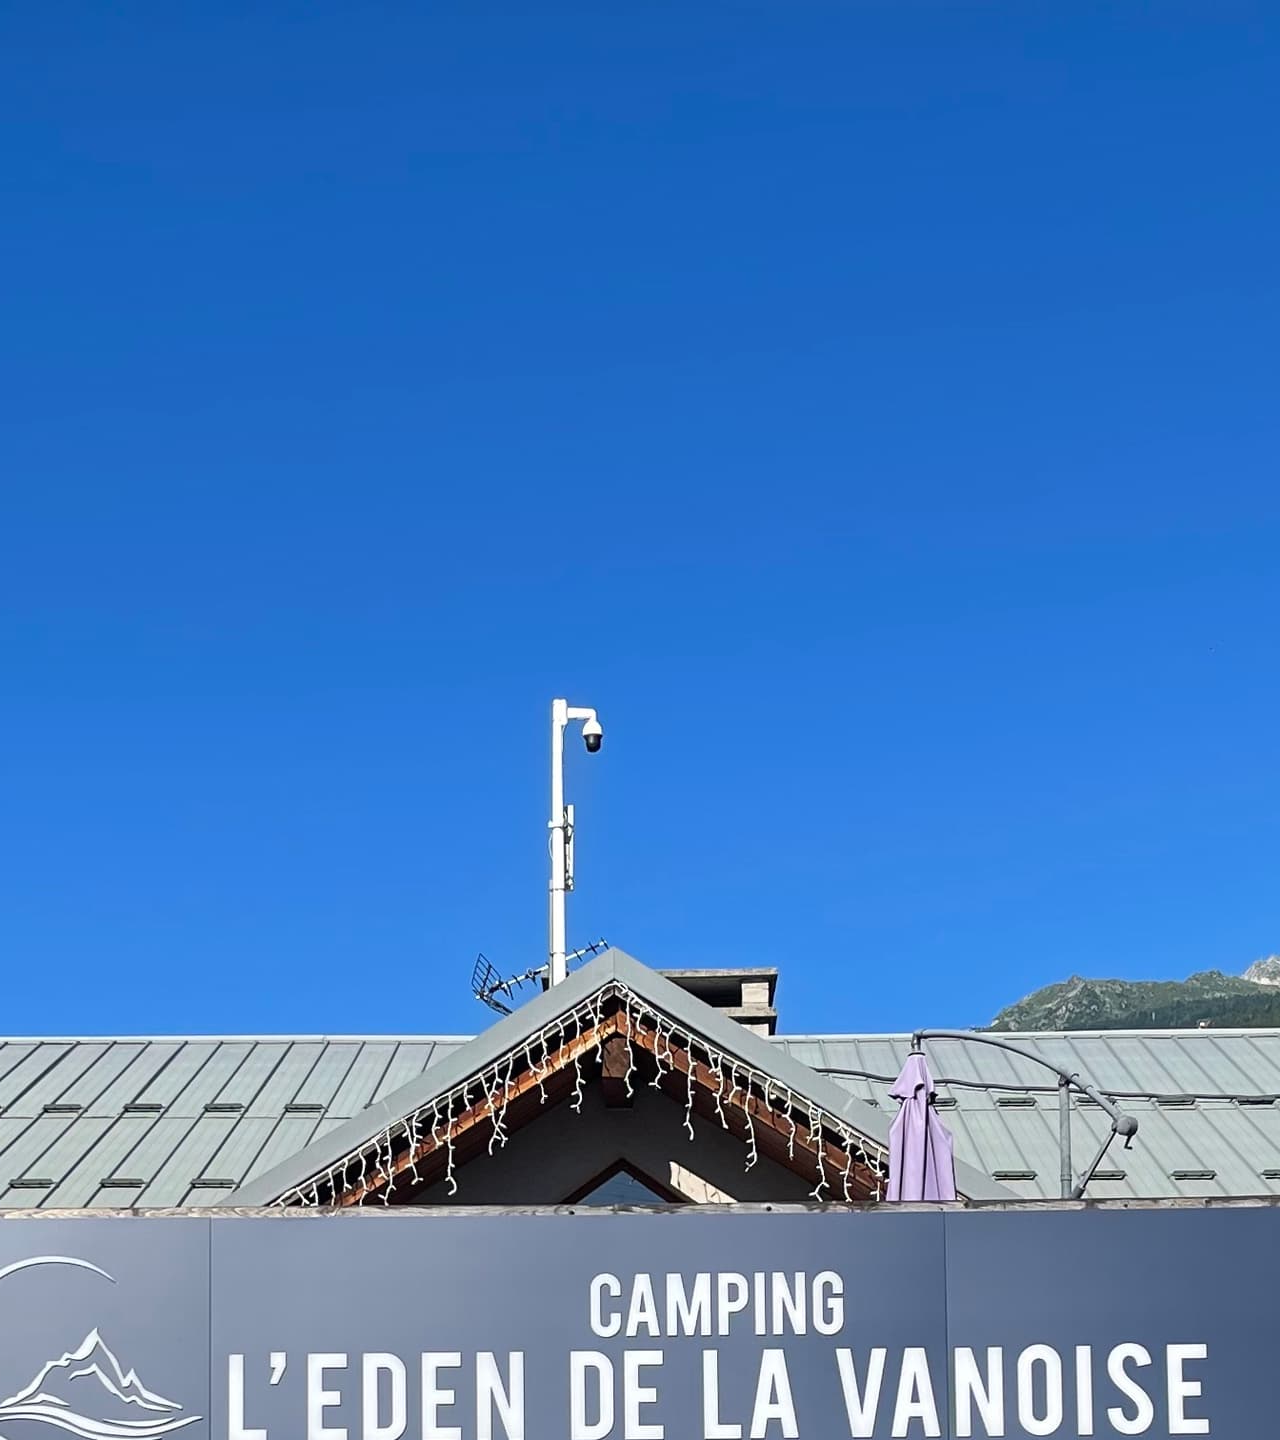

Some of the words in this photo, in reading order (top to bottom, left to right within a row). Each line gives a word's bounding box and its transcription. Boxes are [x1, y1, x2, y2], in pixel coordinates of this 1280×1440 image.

[589, 1271, 845, 1338] CAMPING
[570, 1349, 666, 1440] DE
[702, 1348, 801, 1440] LA
[835, 1342, 1211, 1439] VANOISE
